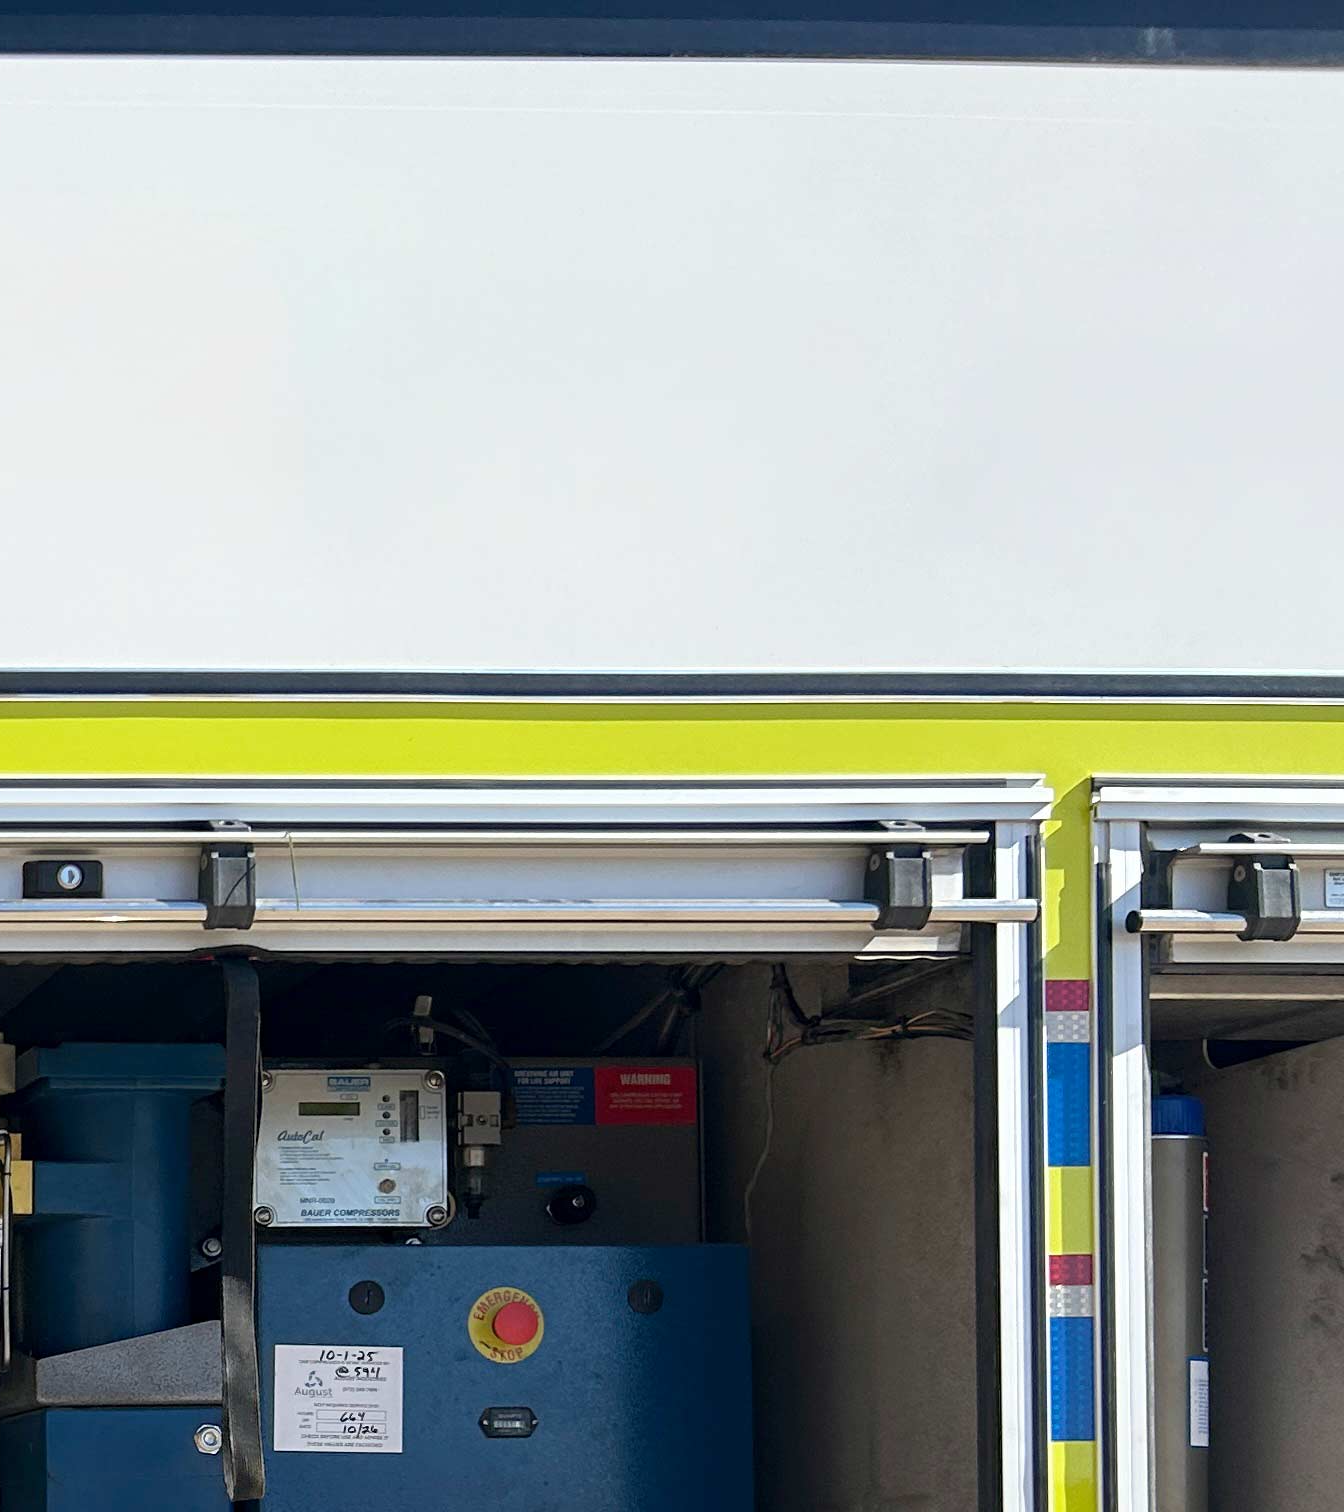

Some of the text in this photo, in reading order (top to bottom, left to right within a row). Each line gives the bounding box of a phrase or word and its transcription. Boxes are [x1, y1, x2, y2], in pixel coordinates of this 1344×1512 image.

[620, 1073, 672, 1085] WARNING
[277, 1130, 325, 1144] AutoCal
[301, 1209, 400, 1217] BAUER COMPRESSORS
[294, 1387, 333, 1398] August
